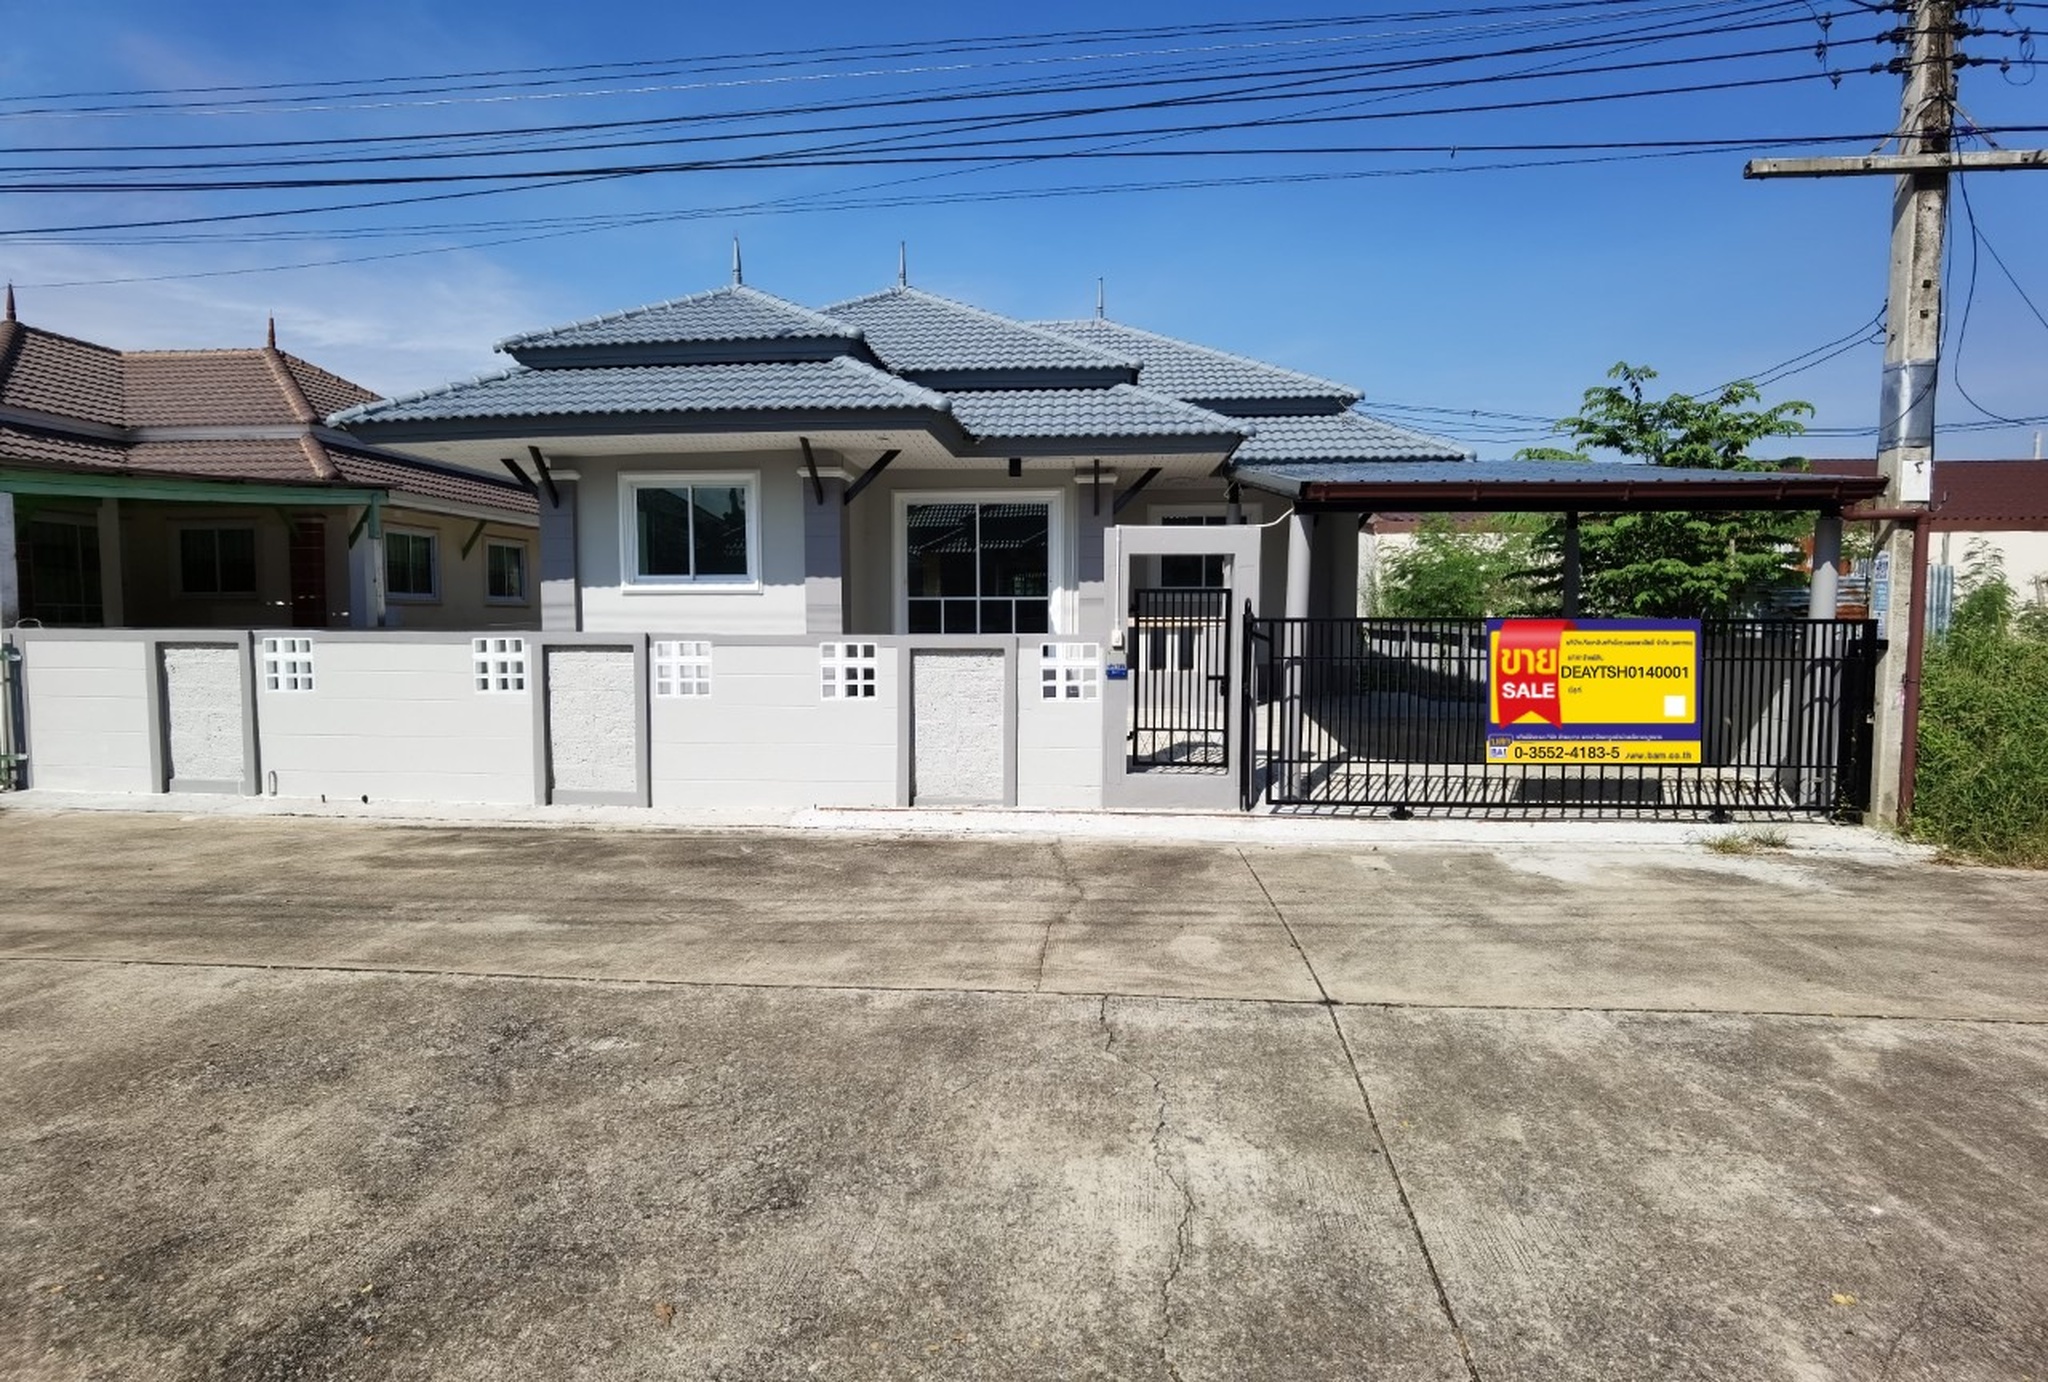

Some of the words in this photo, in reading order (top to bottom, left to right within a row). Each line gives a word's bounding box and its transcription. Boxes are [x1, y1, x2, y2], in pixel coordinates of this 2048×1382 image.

[1501, 648, 1557, 675] ขาย
[1561, 665, 1689, 679] DEAYTSH0140001
[1501, 682, 1556, 698] SALE
[1514, 746, 1620, 759] 0-3552-4183-5
